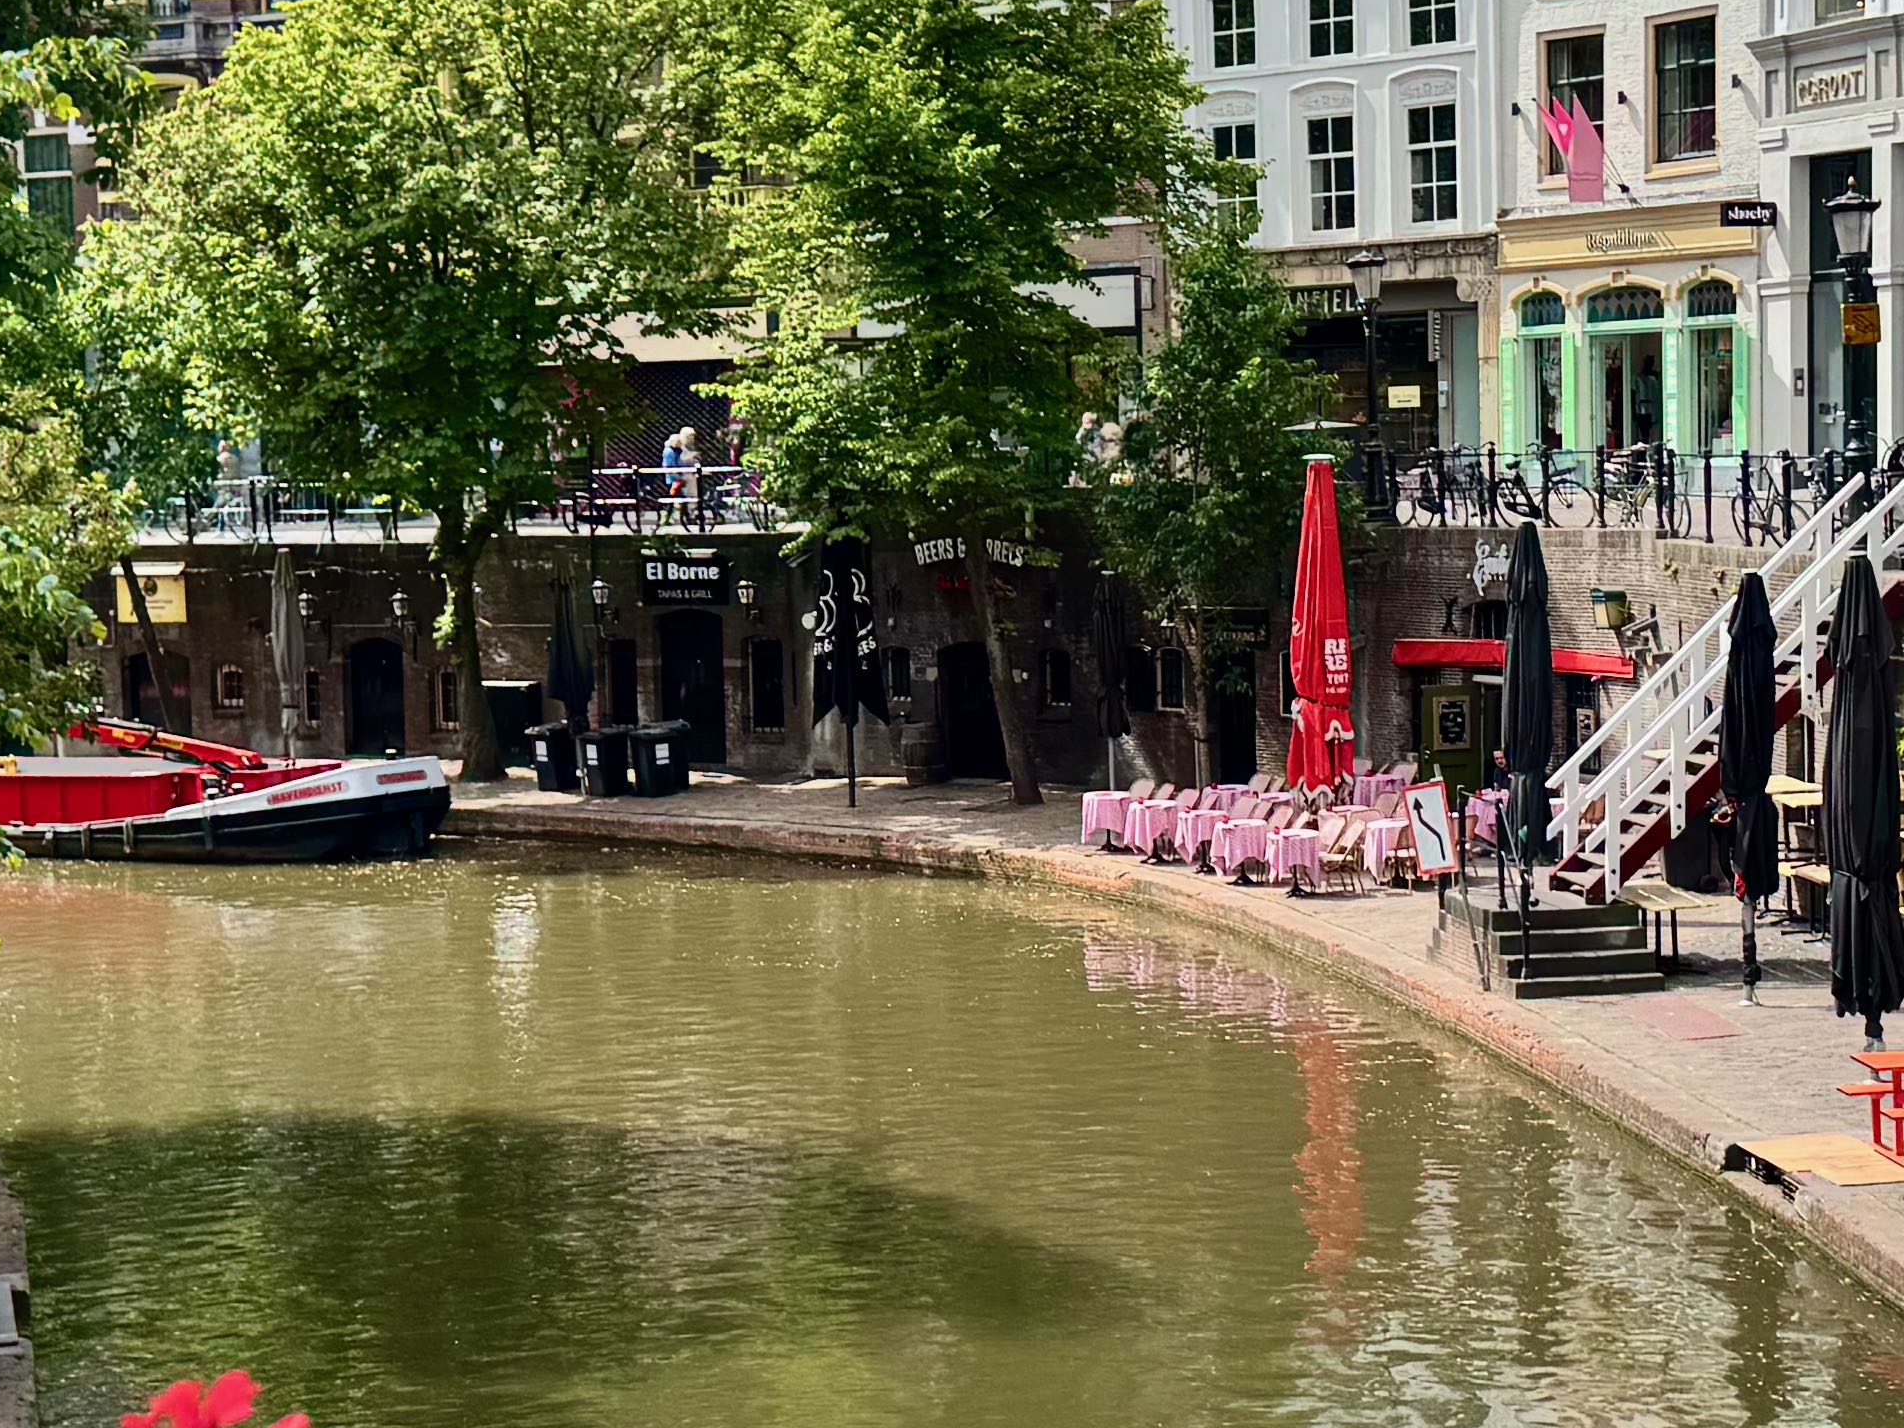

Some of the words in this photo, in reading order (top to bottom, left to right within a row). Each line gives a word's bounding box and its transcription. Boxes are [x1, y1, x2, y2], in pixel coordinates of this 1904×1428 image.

[914, 537, 954, 565] BEERS
[645, 562, 663, 580] El
[667, 562, 720, 580] Borne
